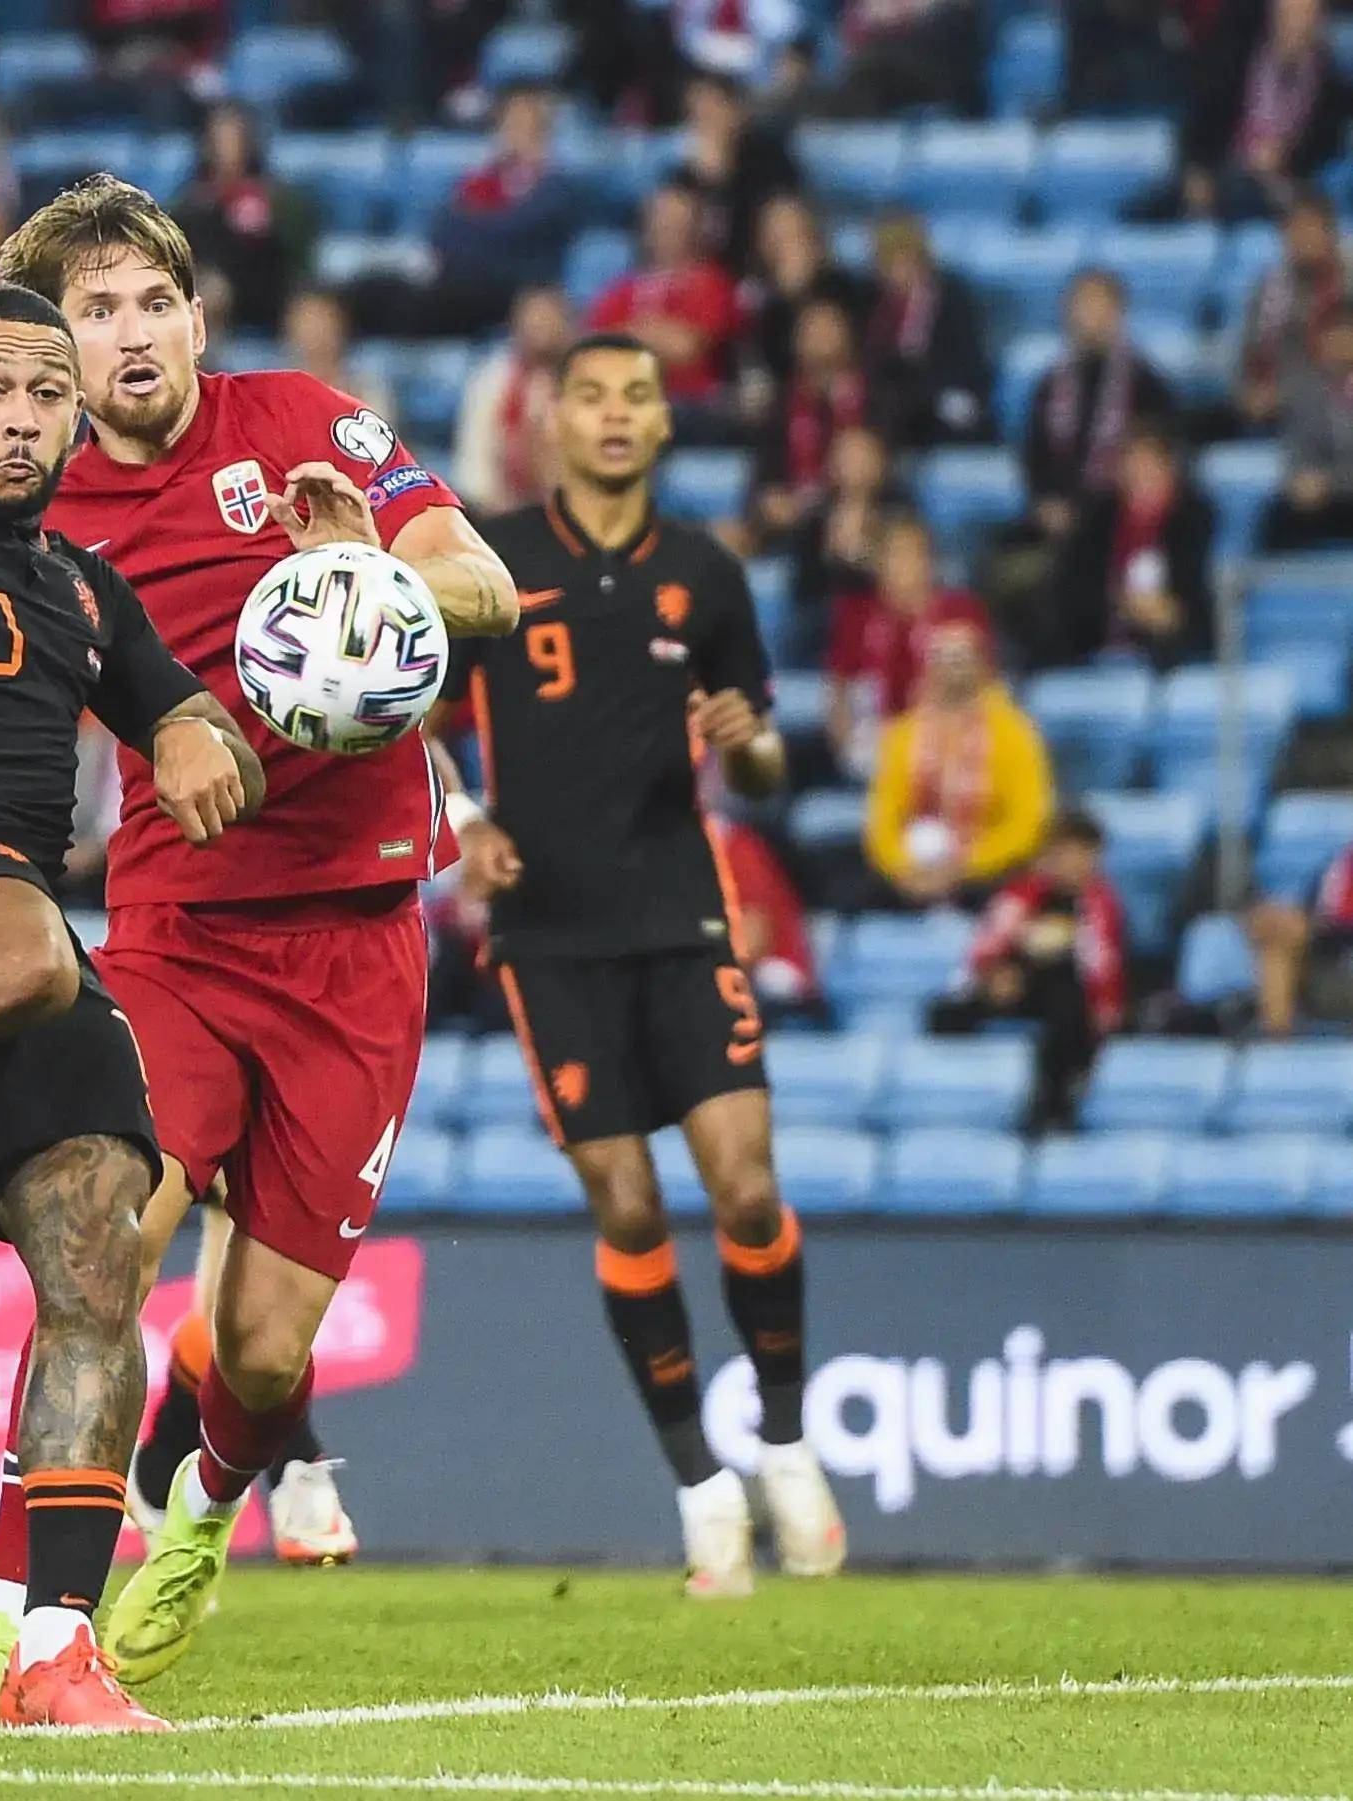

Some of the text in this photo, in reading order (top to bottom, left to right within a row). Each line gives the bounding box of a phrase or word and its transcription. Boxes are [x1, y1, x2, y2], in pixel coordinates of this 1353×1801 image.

[526, 622, 576, 701] 9
[358, 1115, 396, 1200] 4
[700, 1325, 1318, 1512] equinor
